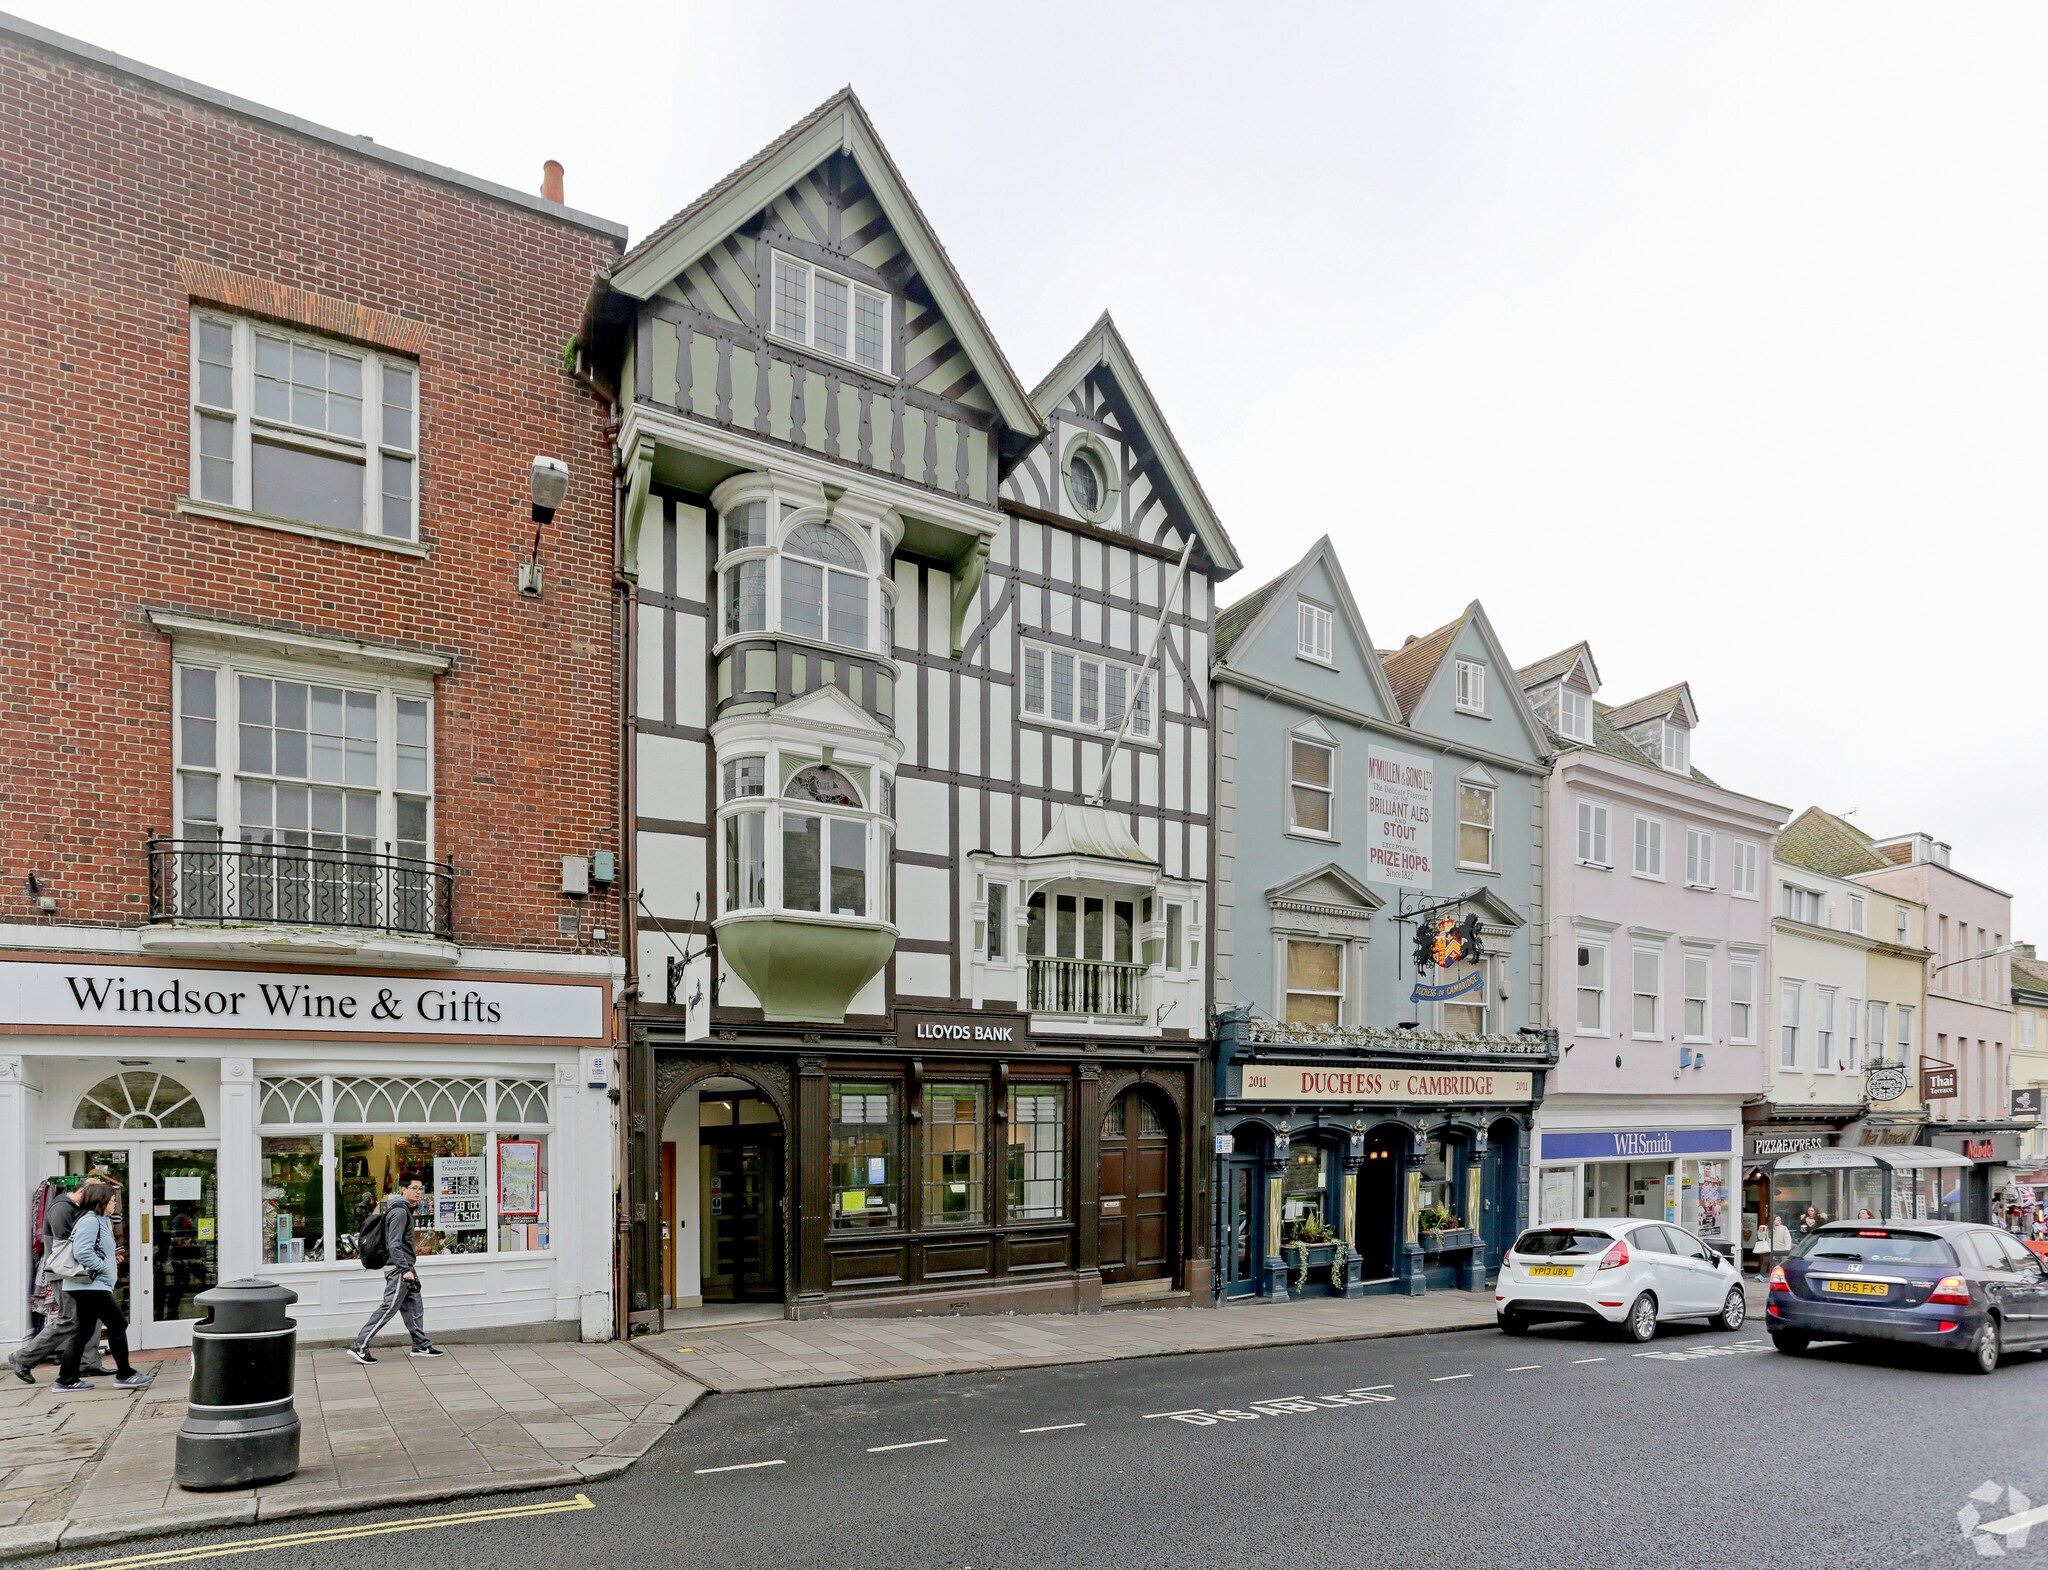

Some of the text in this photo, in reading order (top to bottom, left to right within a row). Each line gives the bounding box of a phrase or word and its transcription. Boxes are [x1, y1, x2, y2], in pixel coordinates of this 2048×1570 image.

[1401, 772, 1406, 786] &
[1405, 766, 1423, 790] SONS
[1373, 783, 1428, 801] The Delicate Flavour
[1369, 796, 1409, 818] BRILLIANT
[1383, 821, 1417, 841] STOUT
[1382, 841, 1419, 853] EXCEPTIONAL
[1370, 847, 1431, 872] PRIZE HOPS.
[1416, 986, 1437, 998] DUCHESS
[1446, 974, 1479, 996] CAMBRIDGE
[64, 976, 501, 1023] Windsor Wine & Gifts
[917, 1023, 1013, 1041] LLOYDS BANK
[1248, 1072, 1528, 1096] 2011 DUCHESS OF CAMBRIDGE 2011
[1930, 1075, 1954, 1087] Thai
[1930, 1086, 1954, 1095] Terrace
[1613, 1132, 1673, 1155] WHSmith
[1755, 1137, 1822, 1155] PIZZAEXPRESS
[1966, 1139, 1996, 1159] Nando's
[441, 1165, 478, 1173] Travelmoney
[1534, 1267, 1551, 1275] YP13
[1829, 1281, 1886, 1295] LB05 FKS
[1169, 1393, 1397, 1426] DISABLED
